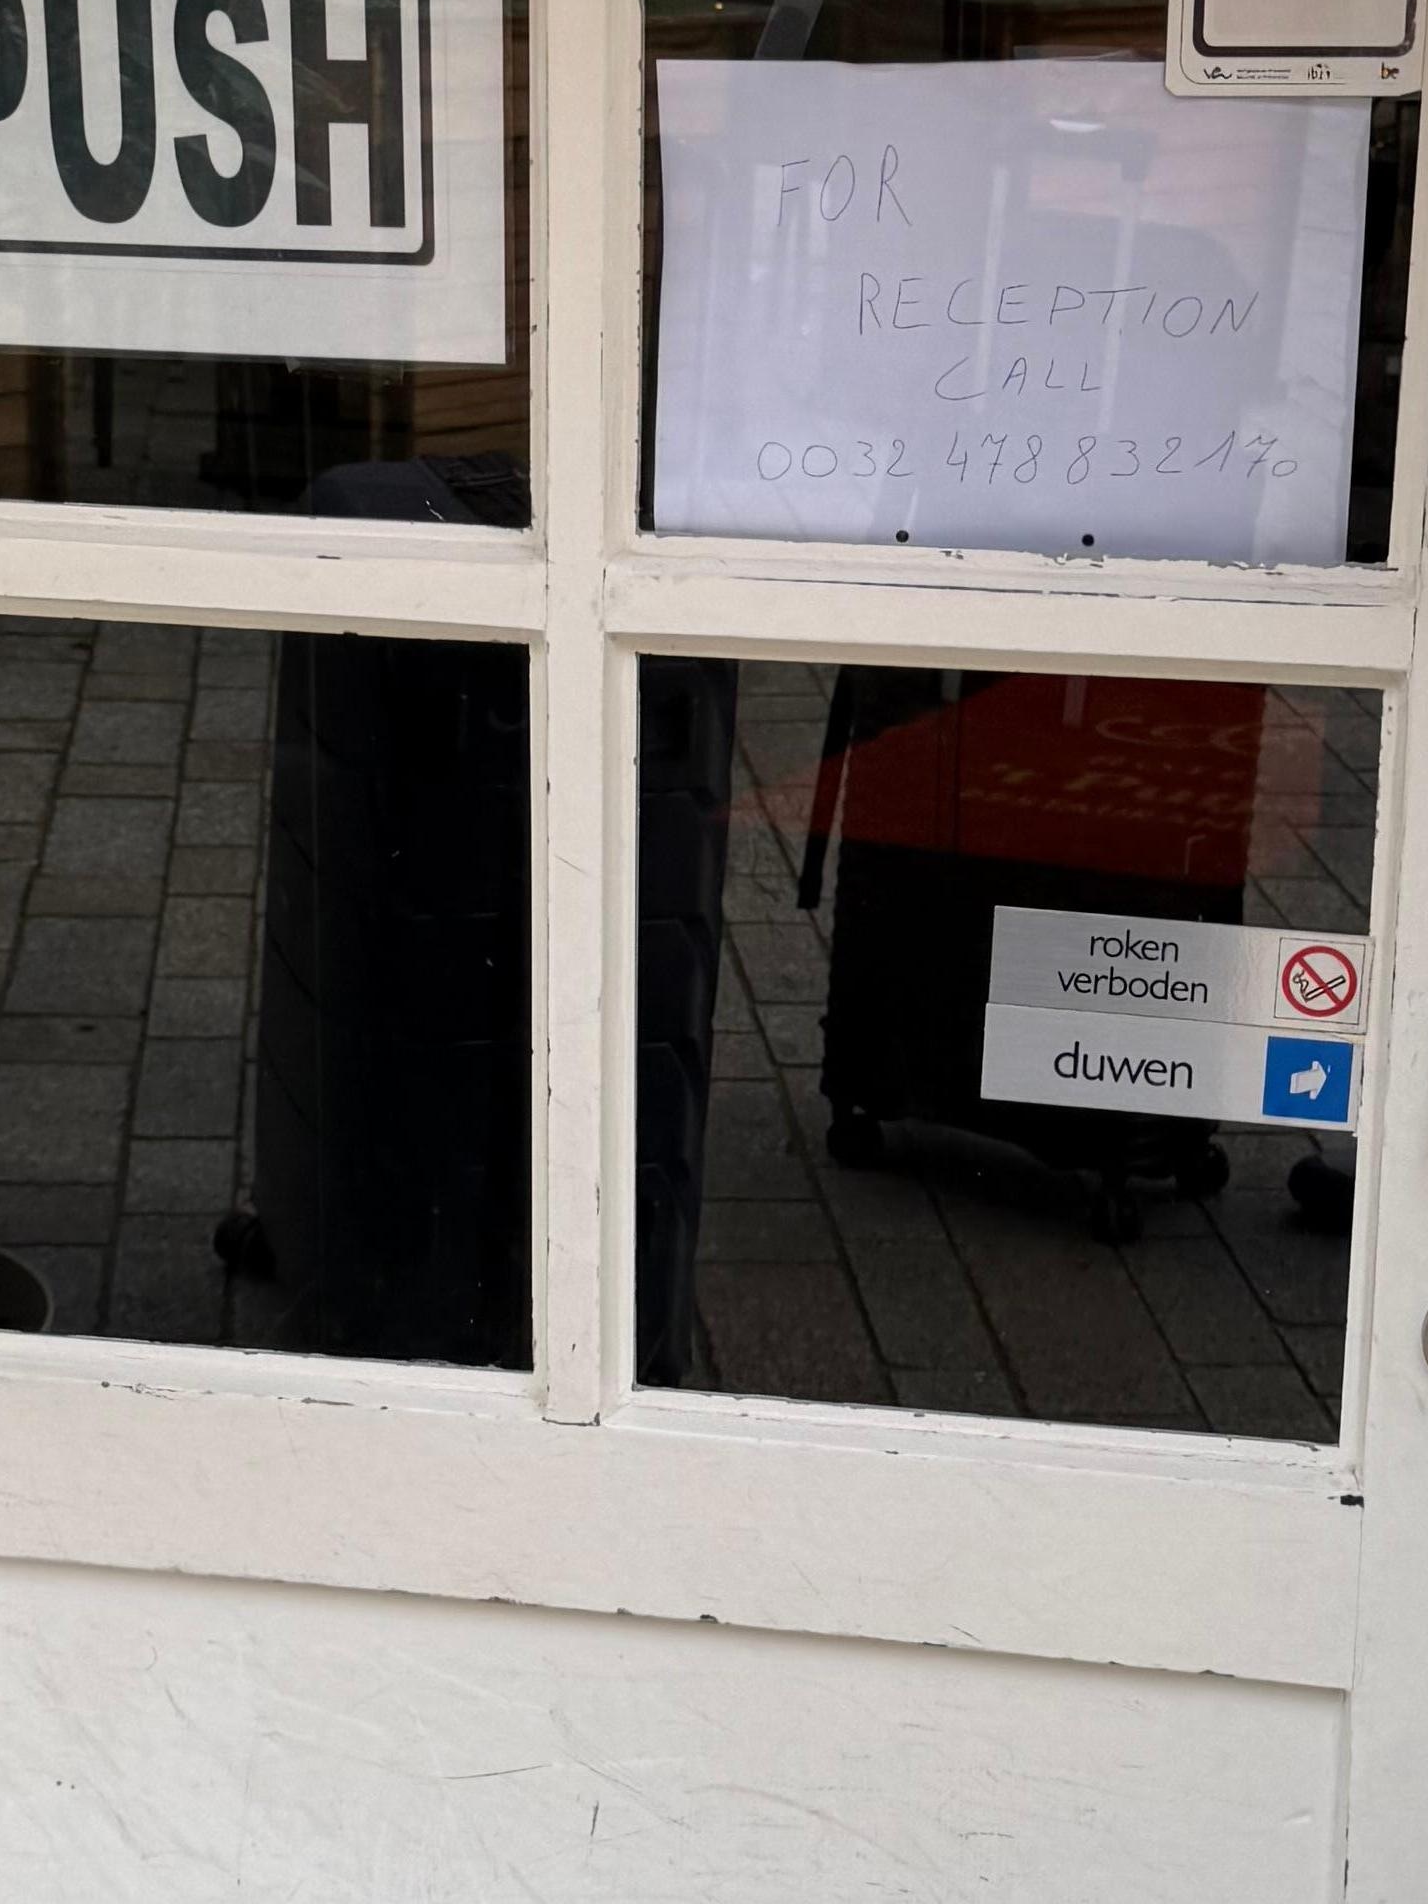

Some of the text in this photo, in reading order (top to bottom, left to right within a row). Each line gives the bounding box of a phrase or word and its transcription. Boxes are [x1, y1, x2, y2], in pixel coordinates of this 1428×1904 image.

[775, 143, 913, 228] FOR
[856, 271, 1260, 339] RECEPTION
[933, 355, 1103, 402] CALL
[757, 437, 915, 483] 0032
[1089, 929, 1180, 964] roken
[1057, 966, 1209, 1005] verboden
[1053, 1040, 1195, 1090] duwen
